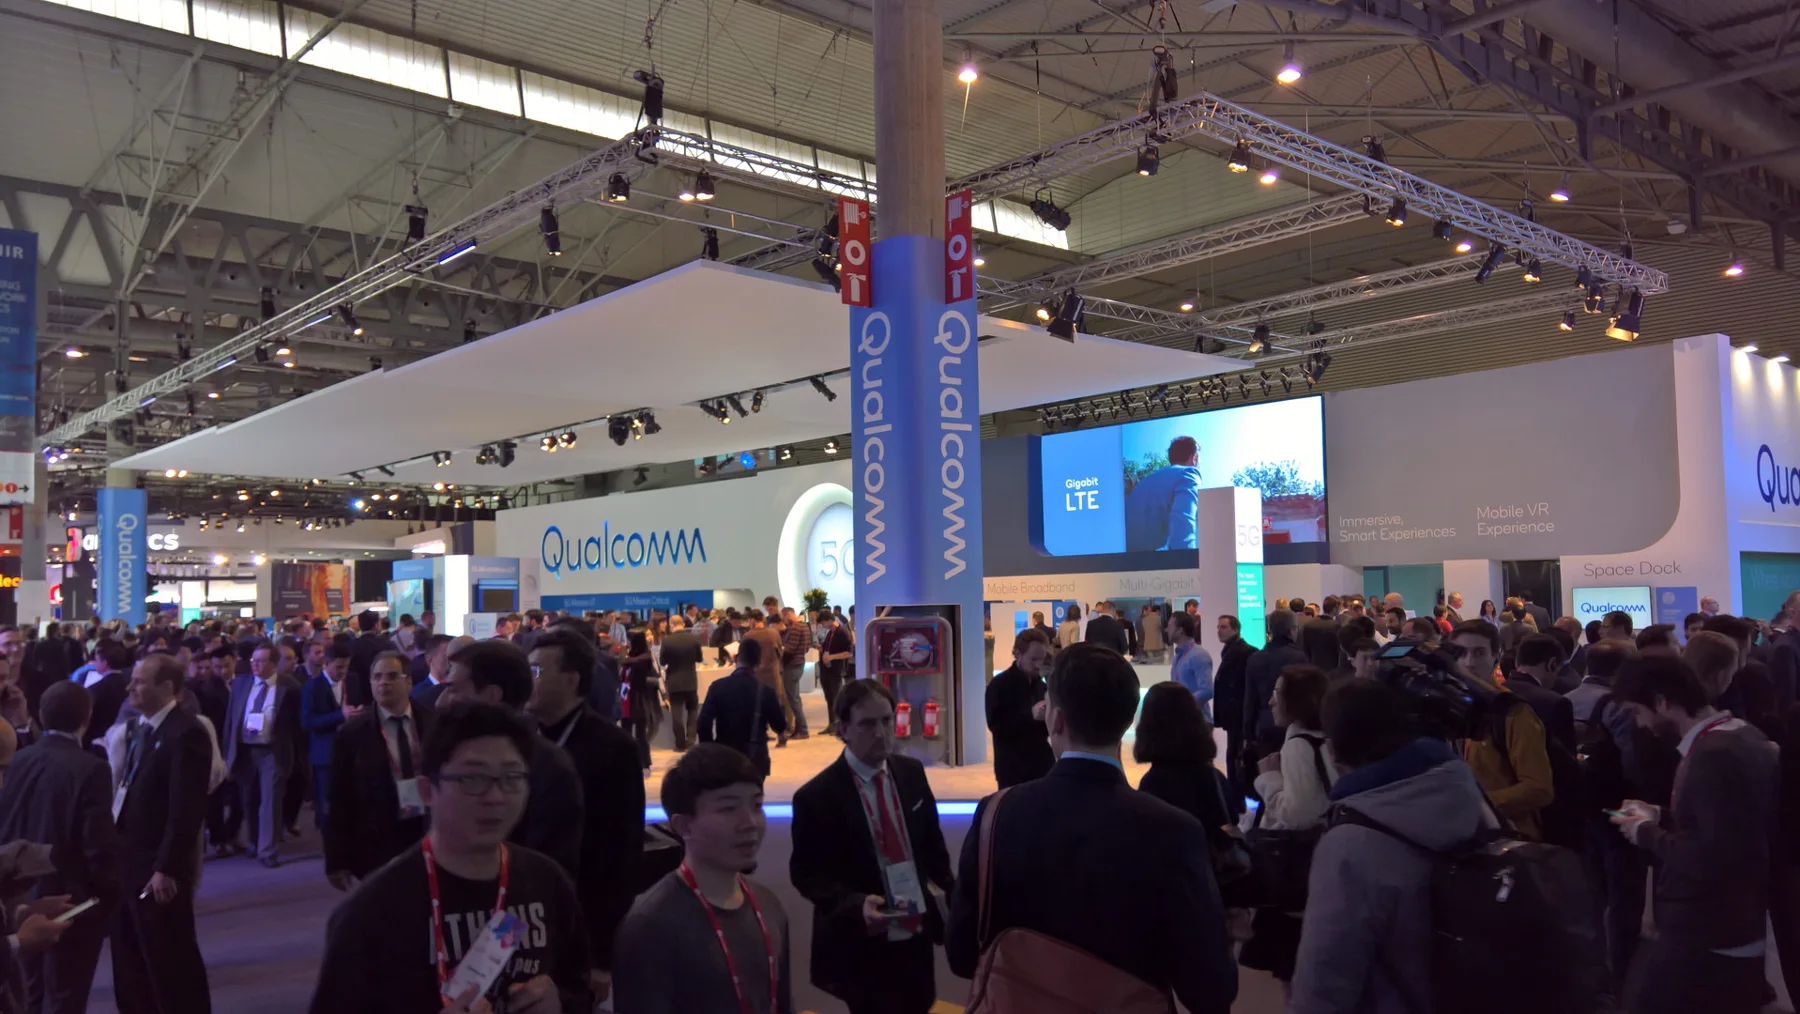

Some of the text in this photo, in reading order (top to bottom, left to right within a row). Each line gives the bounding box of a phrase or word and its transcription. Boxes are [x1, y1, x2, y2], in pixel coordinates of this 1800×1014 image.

[858, 311, 893, 585] Qualcomm
[933, 310, 972, 580] Qualcomm
[1065, 477, 1099, 490] Gigabit
[1066, 490, 1100, 511] LTE
[1339, 513, 1404, 527] Immersive,
[1477, 502, 1550, 520] Mobile VR
[1238, 524, 1261, 546] 5G
[1339, 526, 1456, 543] Smart Experiences
[1477, 520, 1555, 538] Experience
[541, 520, 707, 581] Qualcomm
[116, 513, 138, 614] Qualcomm
[1584, 560, 1682, 579] Space Dock
[987, 581, 1075, 595] Mobile Broadband
[1581, 601, 1646, 614] Qualcomm
